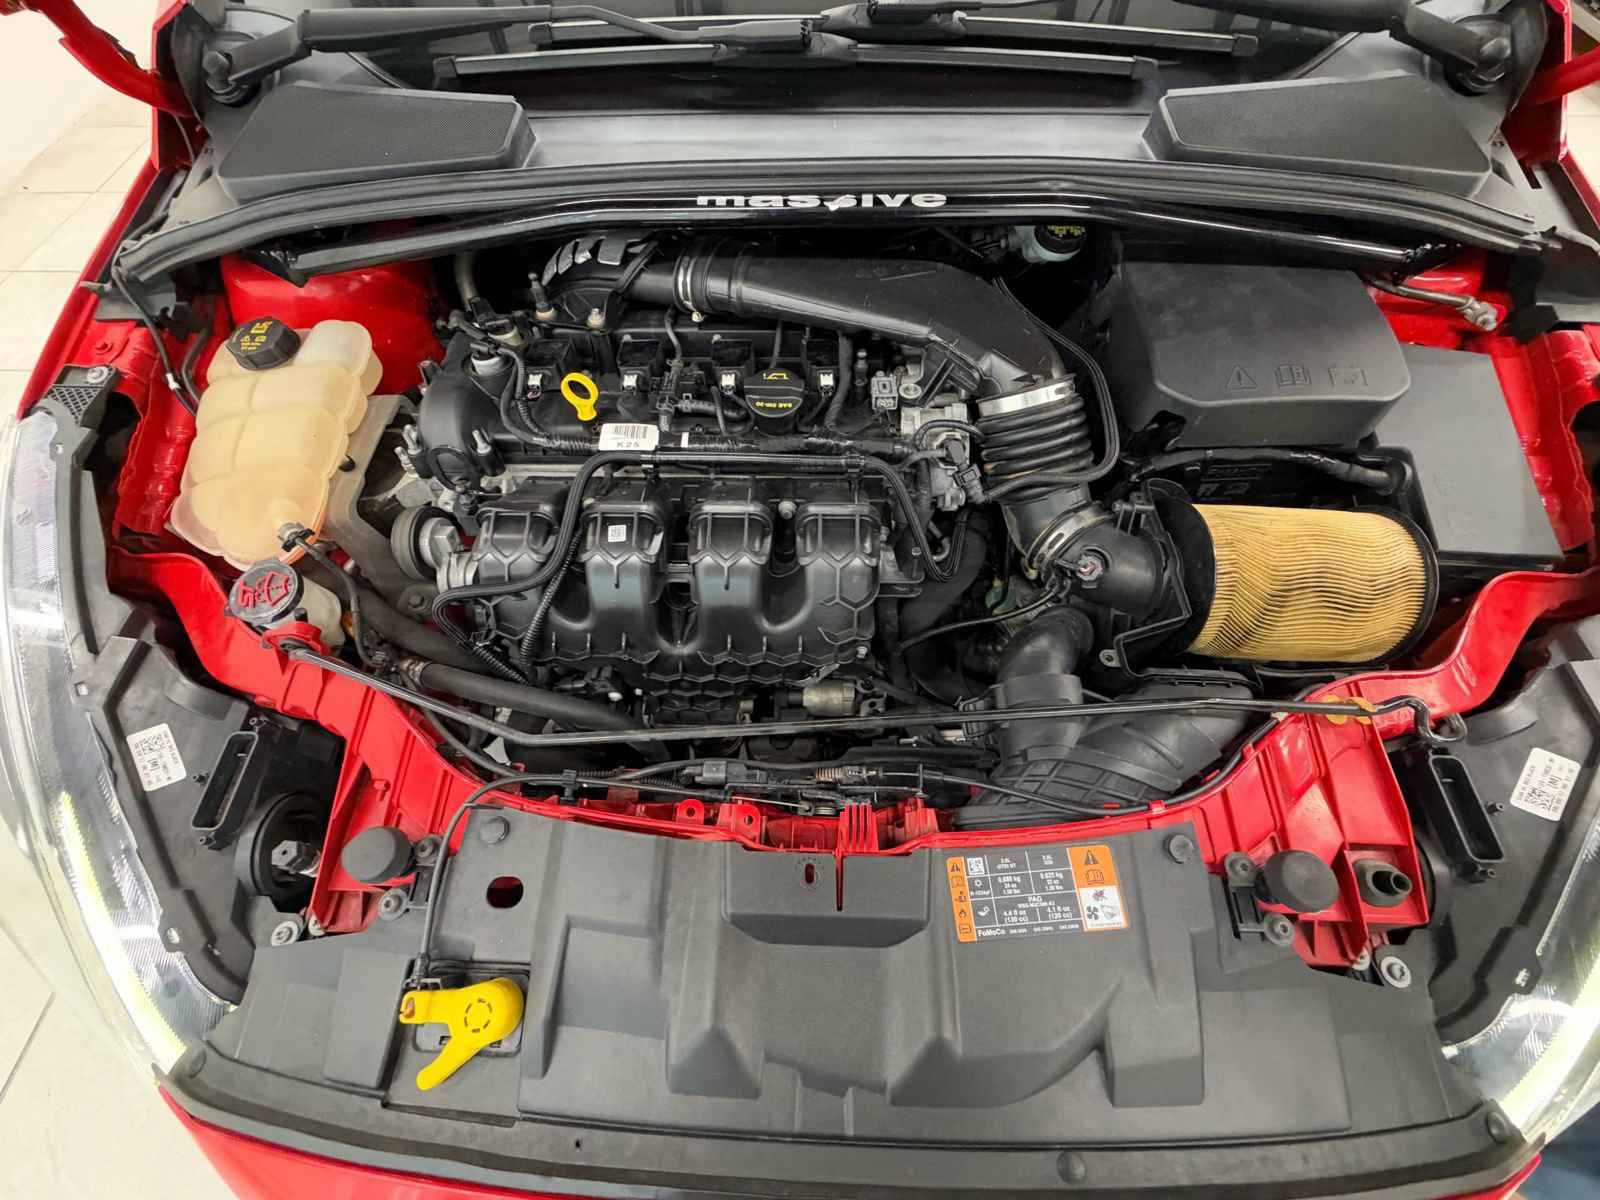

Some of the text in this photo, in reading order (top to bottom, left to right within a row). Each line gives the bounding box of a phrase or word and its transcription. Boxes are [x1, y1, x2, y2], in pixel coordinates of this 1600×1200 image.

[697, 193, 947, 209] massive
[1013, 875, 1021, 883] kg
[1055, 871, 1064, 880] kg
[1004, 915, 1029, 924] (130 cc)
[1048, 912, 1062, 920] (120
[977, 928, 1006, 936] FoMoCo
